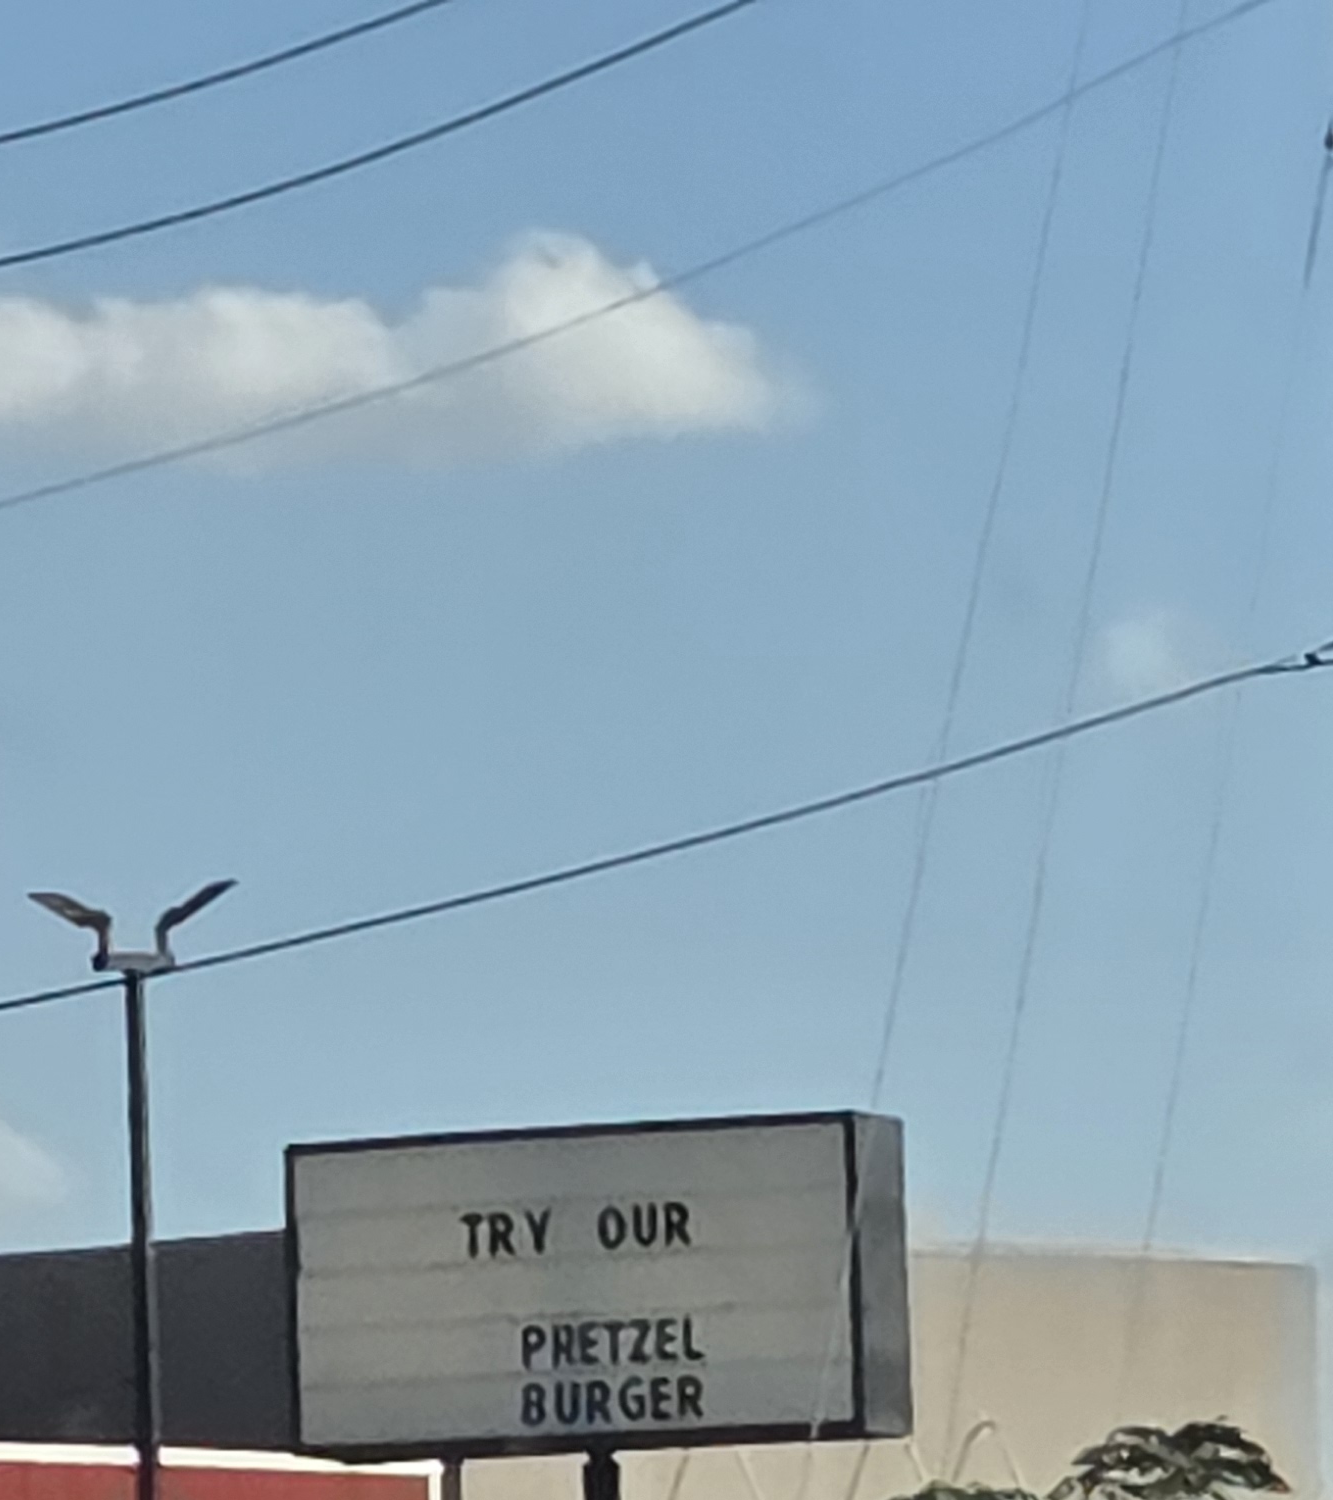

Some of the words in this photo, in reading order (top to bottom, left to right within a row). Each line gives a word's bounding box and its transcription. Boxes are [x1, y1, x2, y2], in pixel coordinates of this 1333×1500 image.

[458, 1208, 552, 1259] TRY
[596, 1202, 693, 1251] OUR
[519, 1316, 707, 1371] PRETZEL
[519, 1374, 705, 1427] BURGER
